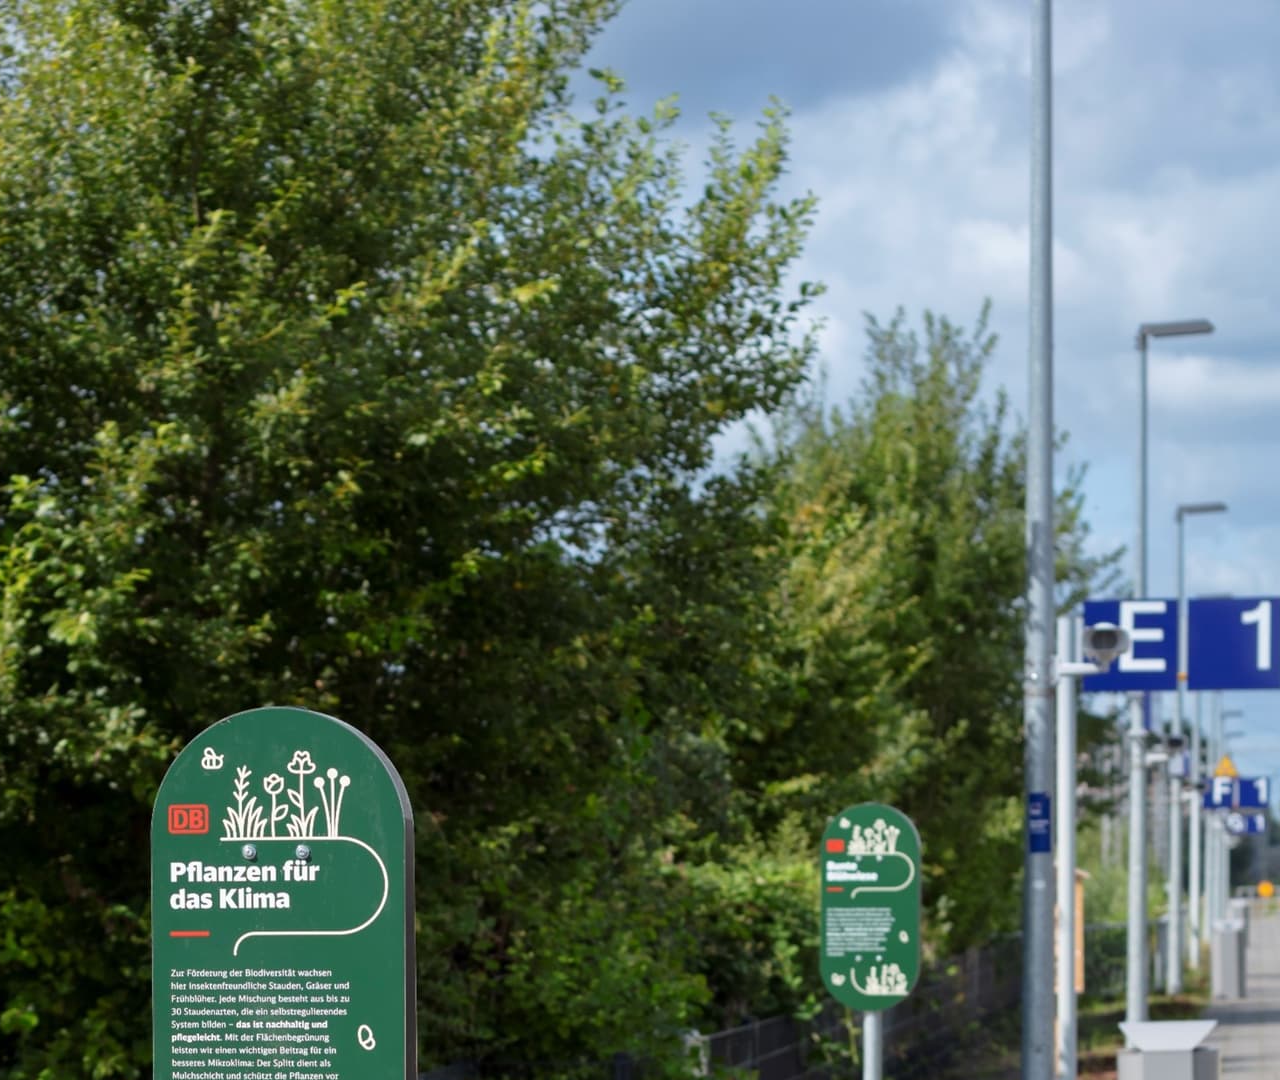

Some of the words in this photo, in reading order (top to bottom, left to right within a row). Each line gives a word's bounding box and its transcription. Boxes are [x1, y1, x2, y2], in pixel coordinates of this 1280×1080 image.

[1118, 600, 1167, 672] E
[1241, 600, 1272, 671] 1
[1213, 776, 1232, 804] F
[1254, 778, 1267, 804] 1
[173, 808, 204, 830] DB
[171, 862, 276, 882] Pflanzen
[283, 860, 319, 881] für
[170, 889, 212, 909] das
[220, 887, 289, 908] Klima
[171, 968, 185, 978] Zur
[187, 968, 228, 979] Förderung
[229, 968, 243, 978] der
[245, 968, 295, 978] Biodiversität
[298, 968, 332, 978] wachsen
[171, 981, 186, 991] hier
[268, 981, 303, 991] Stauden,
[306, 981, 332, 991] Gräser
[334, 981, 349, 991] und
[171, 994, 217, 1004] Frühblüher.
[238, 994, 276, 1005] Mischung
[278, 994, 308, 1004] besteht
[310, 995, 324, 1003] aus
[326, 994, 338, 1003] bis
[340, 995, 350, 1003] zu
[171, 1007, 182, 1017] 30
[184, 1007, 239, 1017] Staudenarten,
[241, 1007, 254, 1016] die
[255, 1007, 268, 1017] ein
[270, 1006, 347, 1018] selbstregulierendes
[171, 1019, 199, 1031] System
[202, 1019, 226, 1029] bilden
[236, 1019, 251, 1029] das
[252, 1019, 264, 1029] ist
[265, 1019, 310, 1031] nachhaltig
[311, 1019, 328, 1029] und
[172, 1032, 222, 1044] pflegeleicht.
[225, 1032, 239, 1042] Mit
[241, 1032, 254, 1042] der
[256, 1032, 329, 1044] Flächenbegrünung
[172, 1045, 198, 1055] leisten
[200, 1046, 213, 1055] wir
[215, 1045, 237, 1055] einen
[239, 1045, 277, 1057] wichtigen
[279, 1045, 308, 1057] Beitrag
[310, 1045, 322, 1055] für
[324, 1046, 336, 1055] ein
[172, 1058, 206, 1068] besseres
[208, 1058, 254, 1068] Mikroklima:
[257, 1058, 271, 1068] Der
[273, 1058, 294, 1069] Splitt
[297, 1058, 318, 1068] dient
[320, 1058, 331, 1068] als
[172, 1071, 224, 1080] Mulchschicht
[226, 1071, 241, 1080] und
[243, 1071, 272, 1080] schützt
[274, 1071, 287, 1080] die
[289, 1071, 323, 1080] Pflanzen
[325, 1073, 338, 1080] vor
